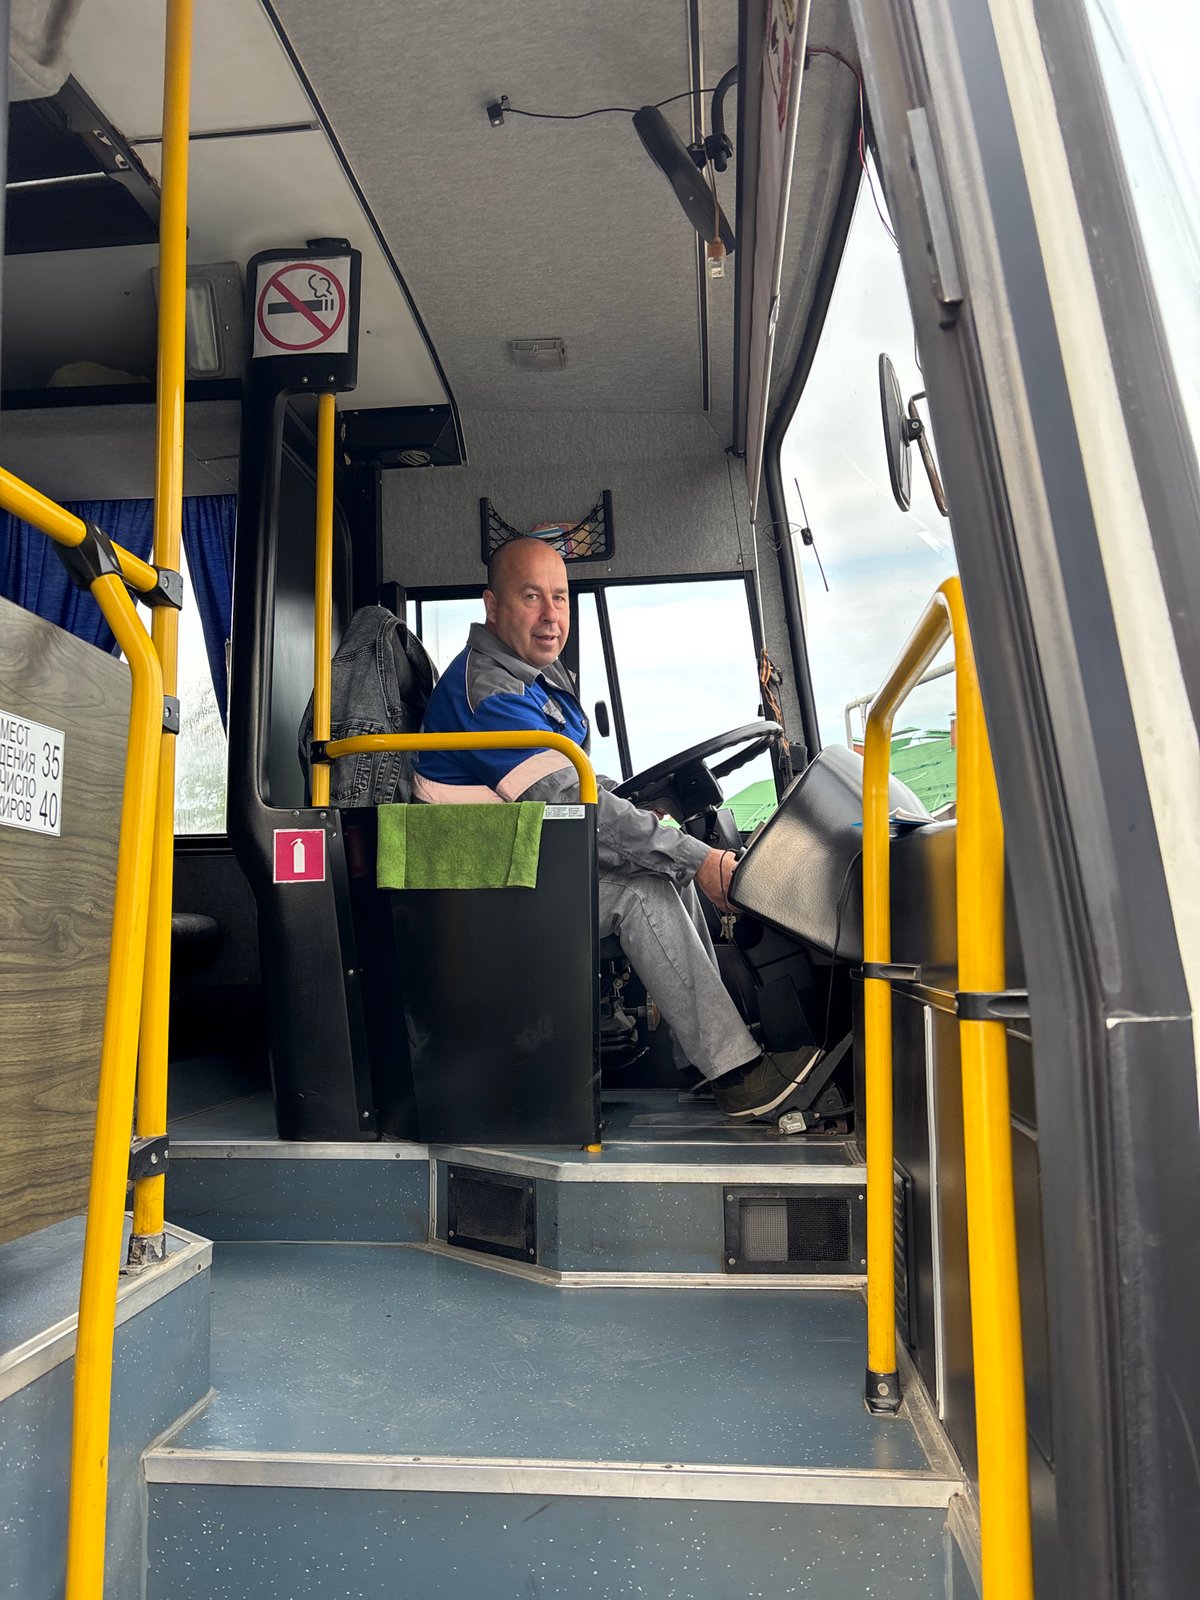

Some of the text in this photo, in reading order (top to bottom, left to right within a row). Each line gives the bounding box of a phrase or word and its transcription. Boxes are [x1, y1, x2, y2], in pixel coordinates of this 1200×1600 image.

[42, 742, 60, 780] 35
[0, 769, 37, 799] ЧИСЛО
[39, 790, 58, 828] 40
